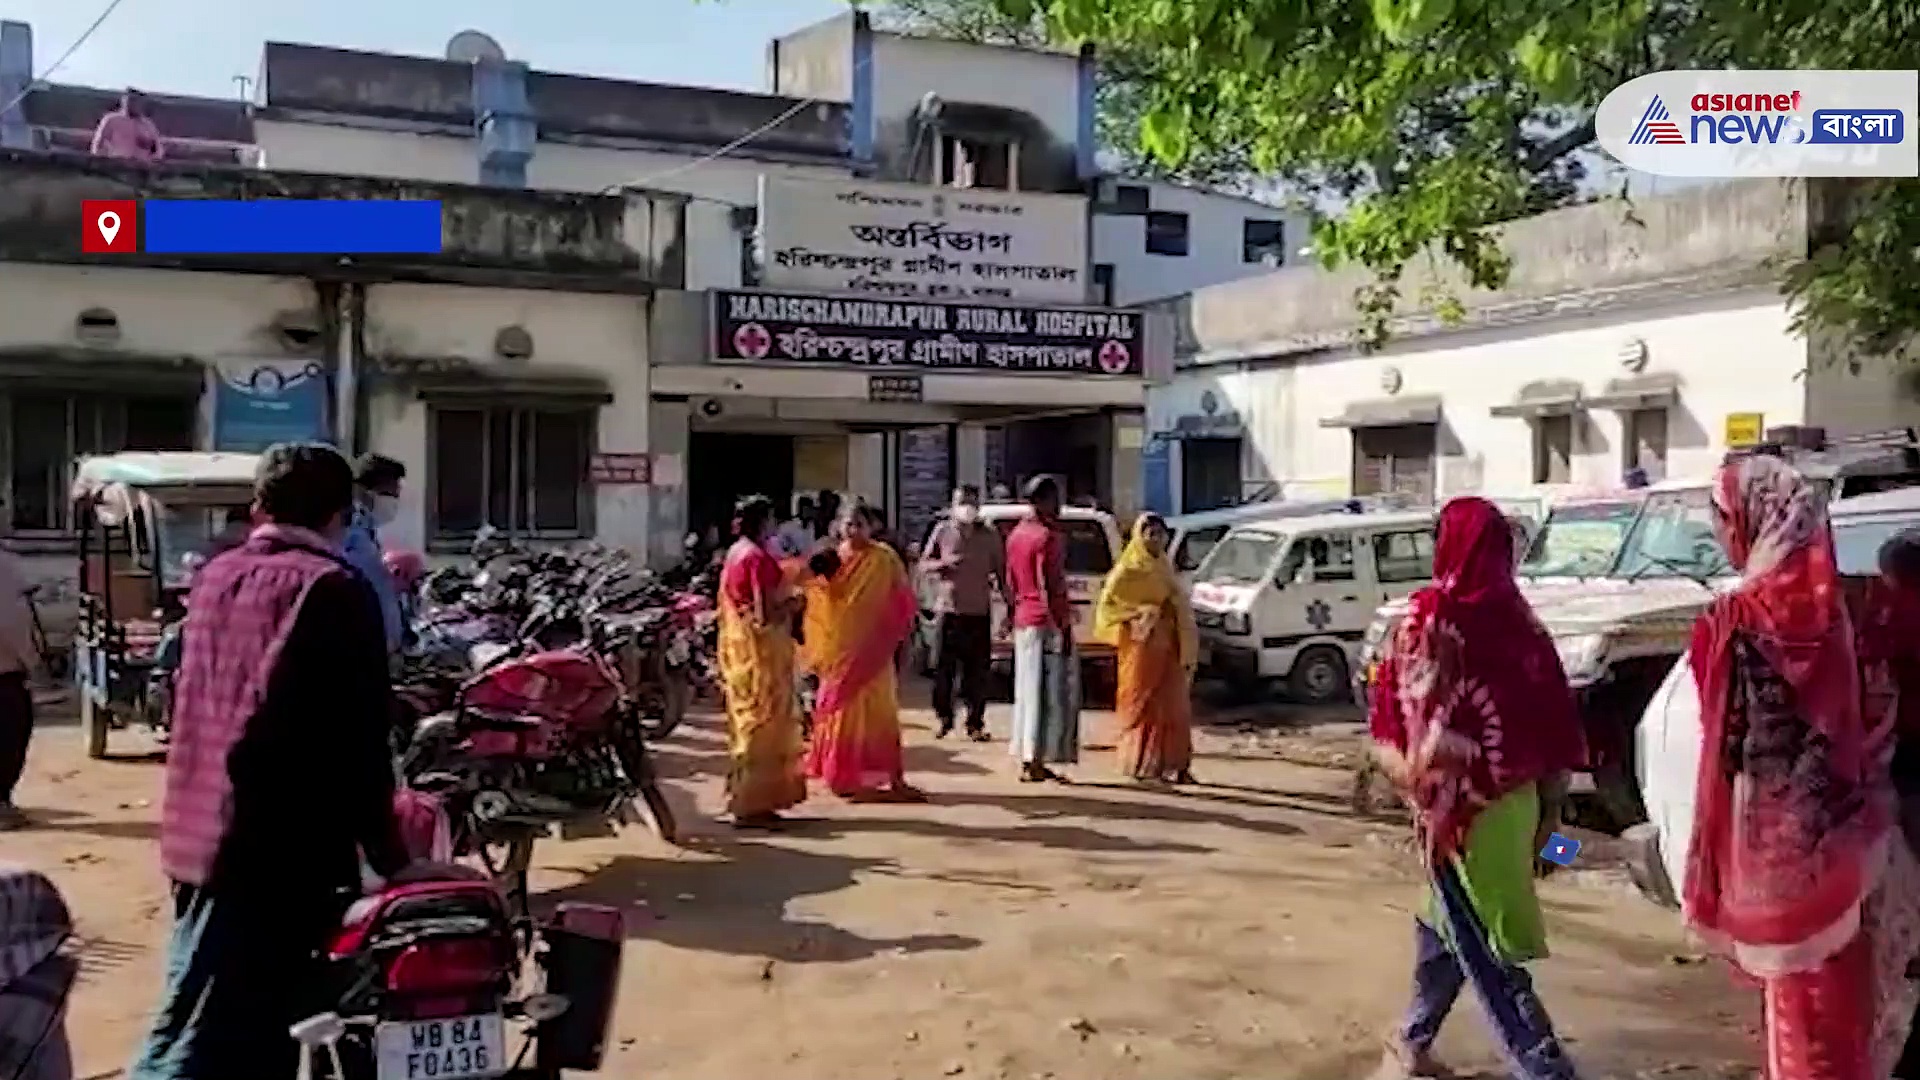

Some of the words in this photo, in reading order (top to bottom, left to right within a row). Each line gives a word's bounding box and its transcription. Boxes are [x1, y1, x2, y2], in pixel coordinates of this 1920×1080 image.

[849, 221, 1013, 253] অন্তর্বিভাগ
[729, 295, 948, 330] HARISCHANDRAPUR
[956, 308, 1028, 334] RURAL
[1034, 312, 1135, 339] HOSPITAL
[984, 342, 1093, 368] হাসপাতাল
[412, 1023, 442, 1049] WB
[452, 1019, 481, 1044] 84
